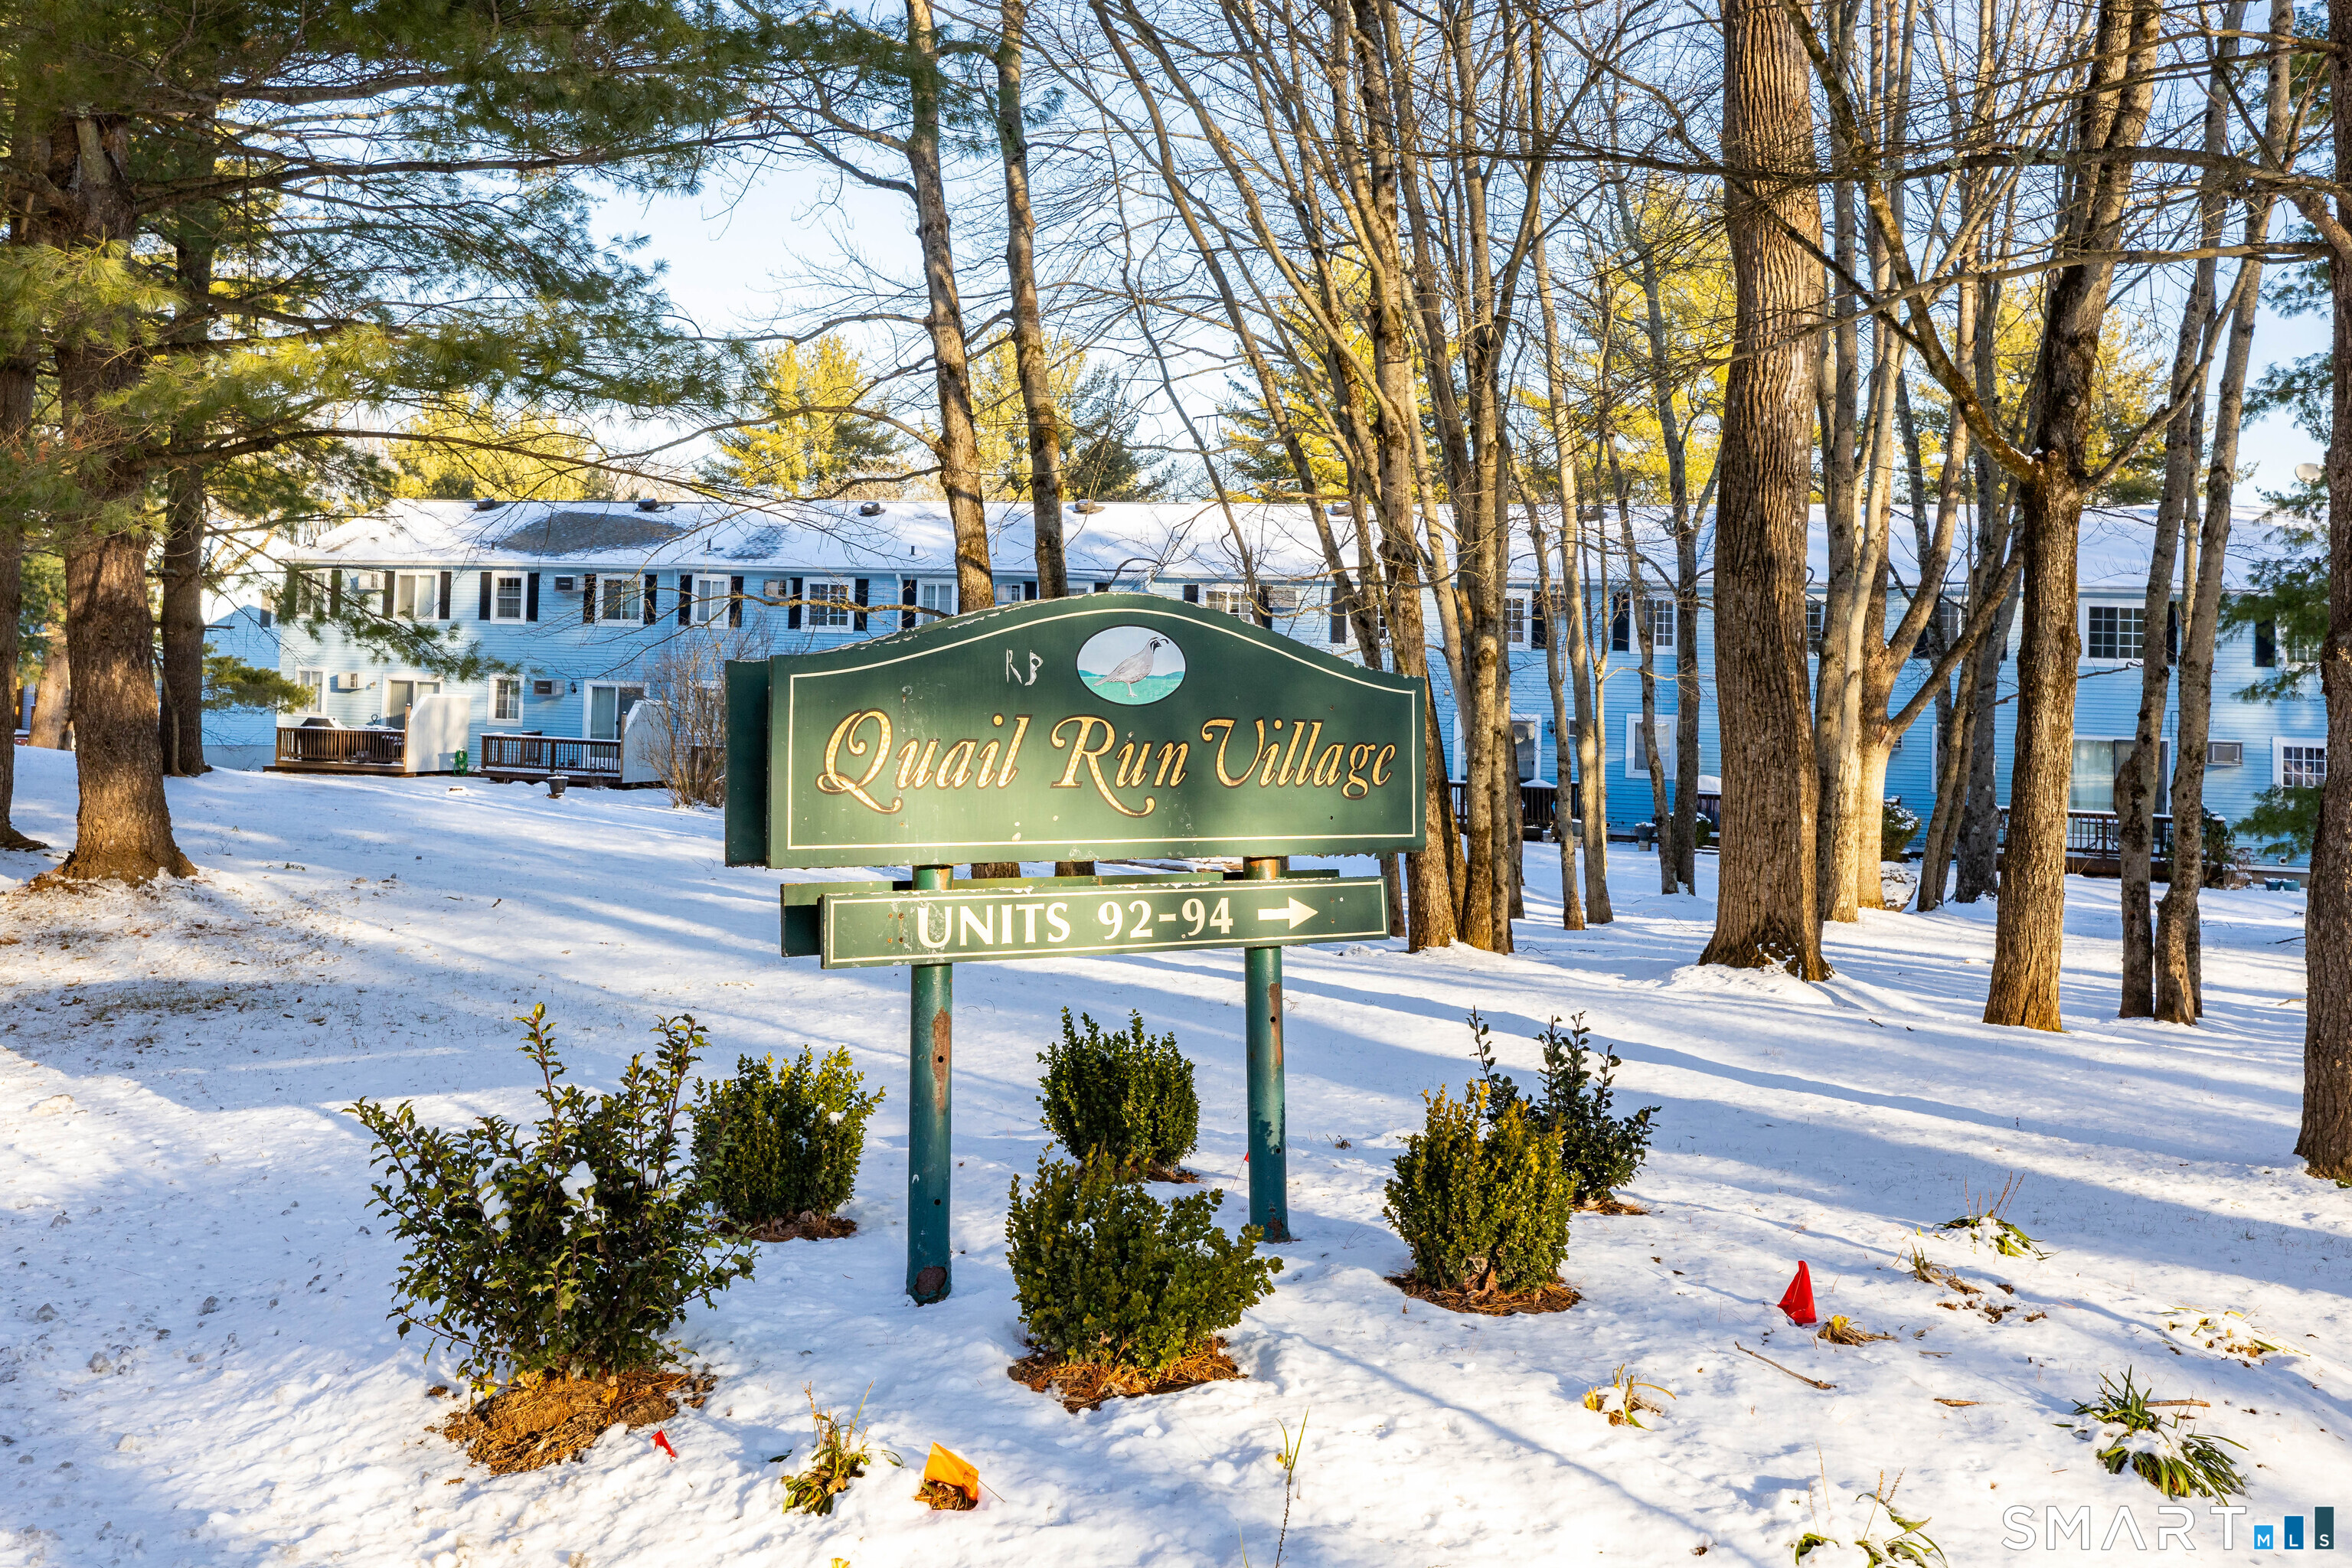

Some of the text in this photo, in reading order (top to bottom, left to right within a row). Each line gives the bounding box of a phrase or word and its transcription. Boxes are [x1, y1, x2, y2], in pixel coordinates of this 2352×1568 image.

[815, 707, 1396, 818] Quail Run Village
[918, 897, 1233, 949] UNITS 92-94
